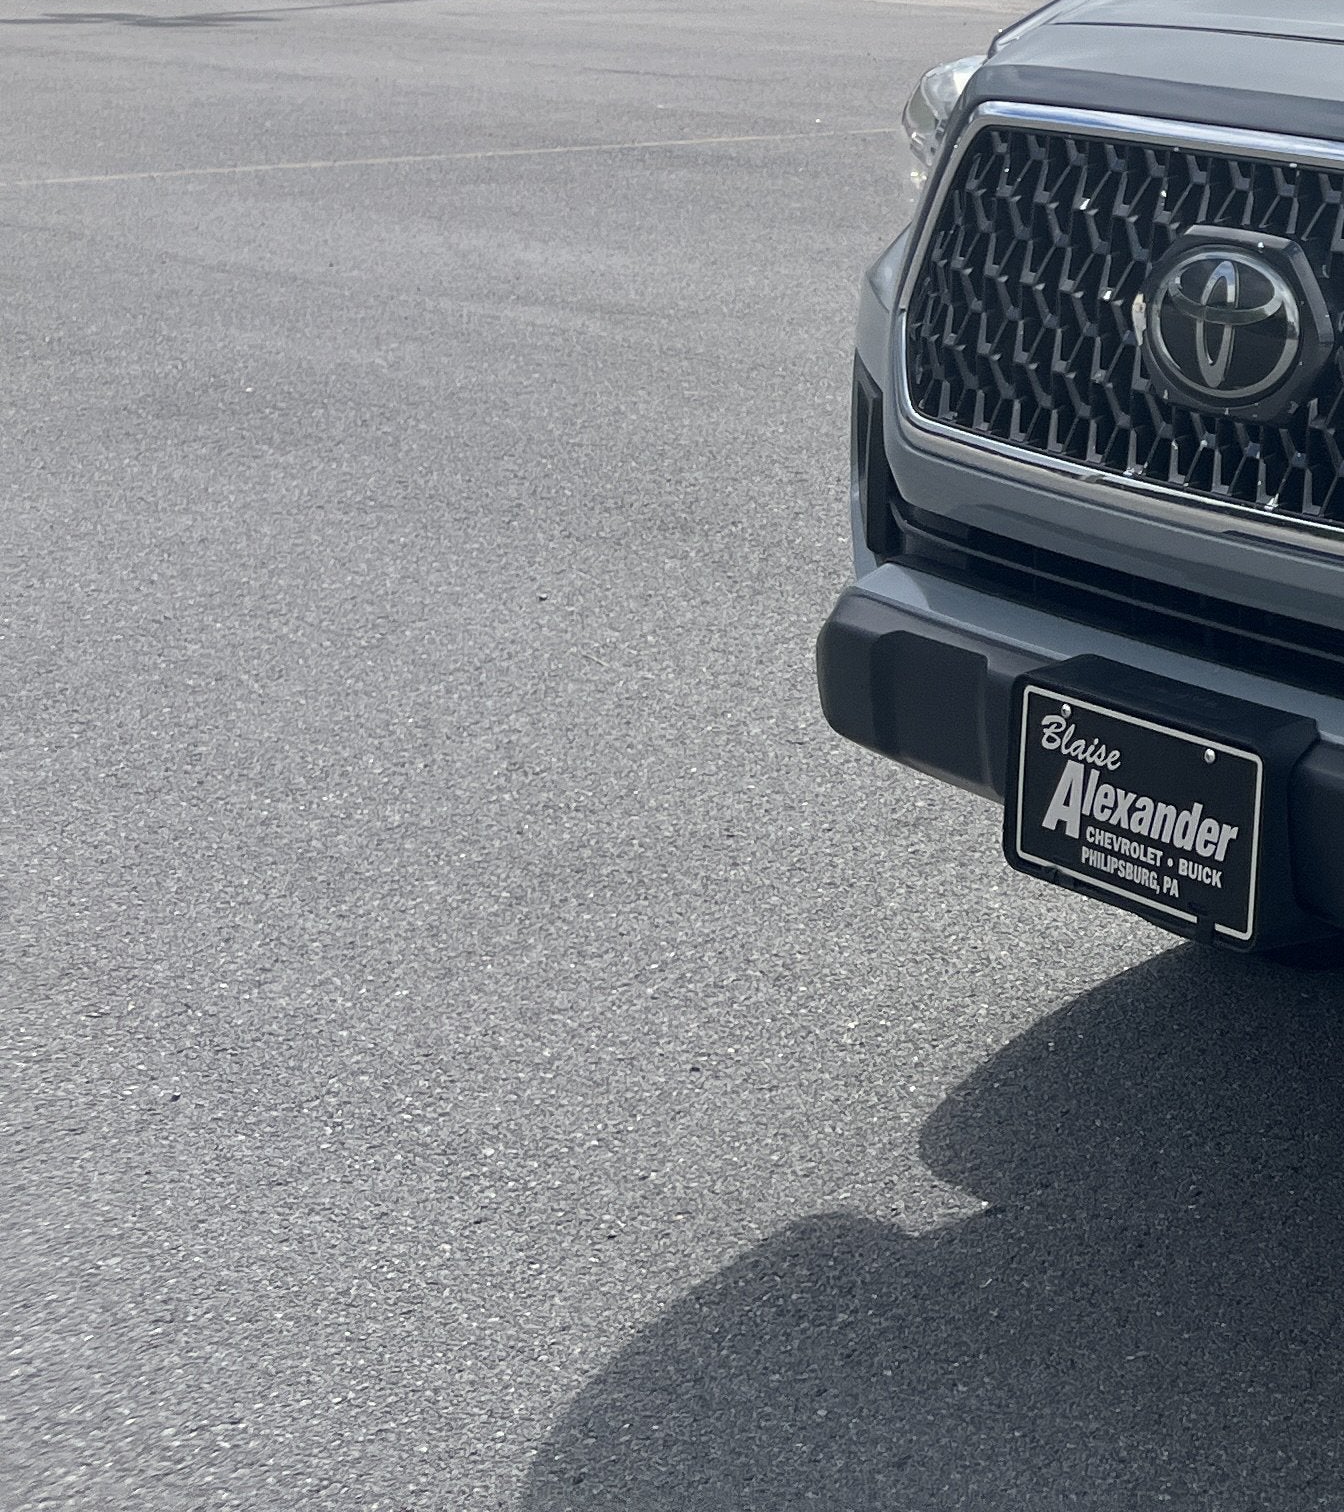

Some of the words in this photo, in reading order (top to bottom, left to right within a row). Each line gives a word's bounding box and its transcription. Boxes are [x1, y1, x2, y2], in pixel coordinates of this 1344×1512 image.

[1041, 714, 1121, 771] Blaise
[1042, 759, 1239, 862] Alexander
[1081, 846, 1160, 895] PHILIPSBURG,
[1162, 876, 1180, 898] PA
[1086, 826, 1163, 867] CHEVROLET
[1178, 861, 1222, 888] BUICK
